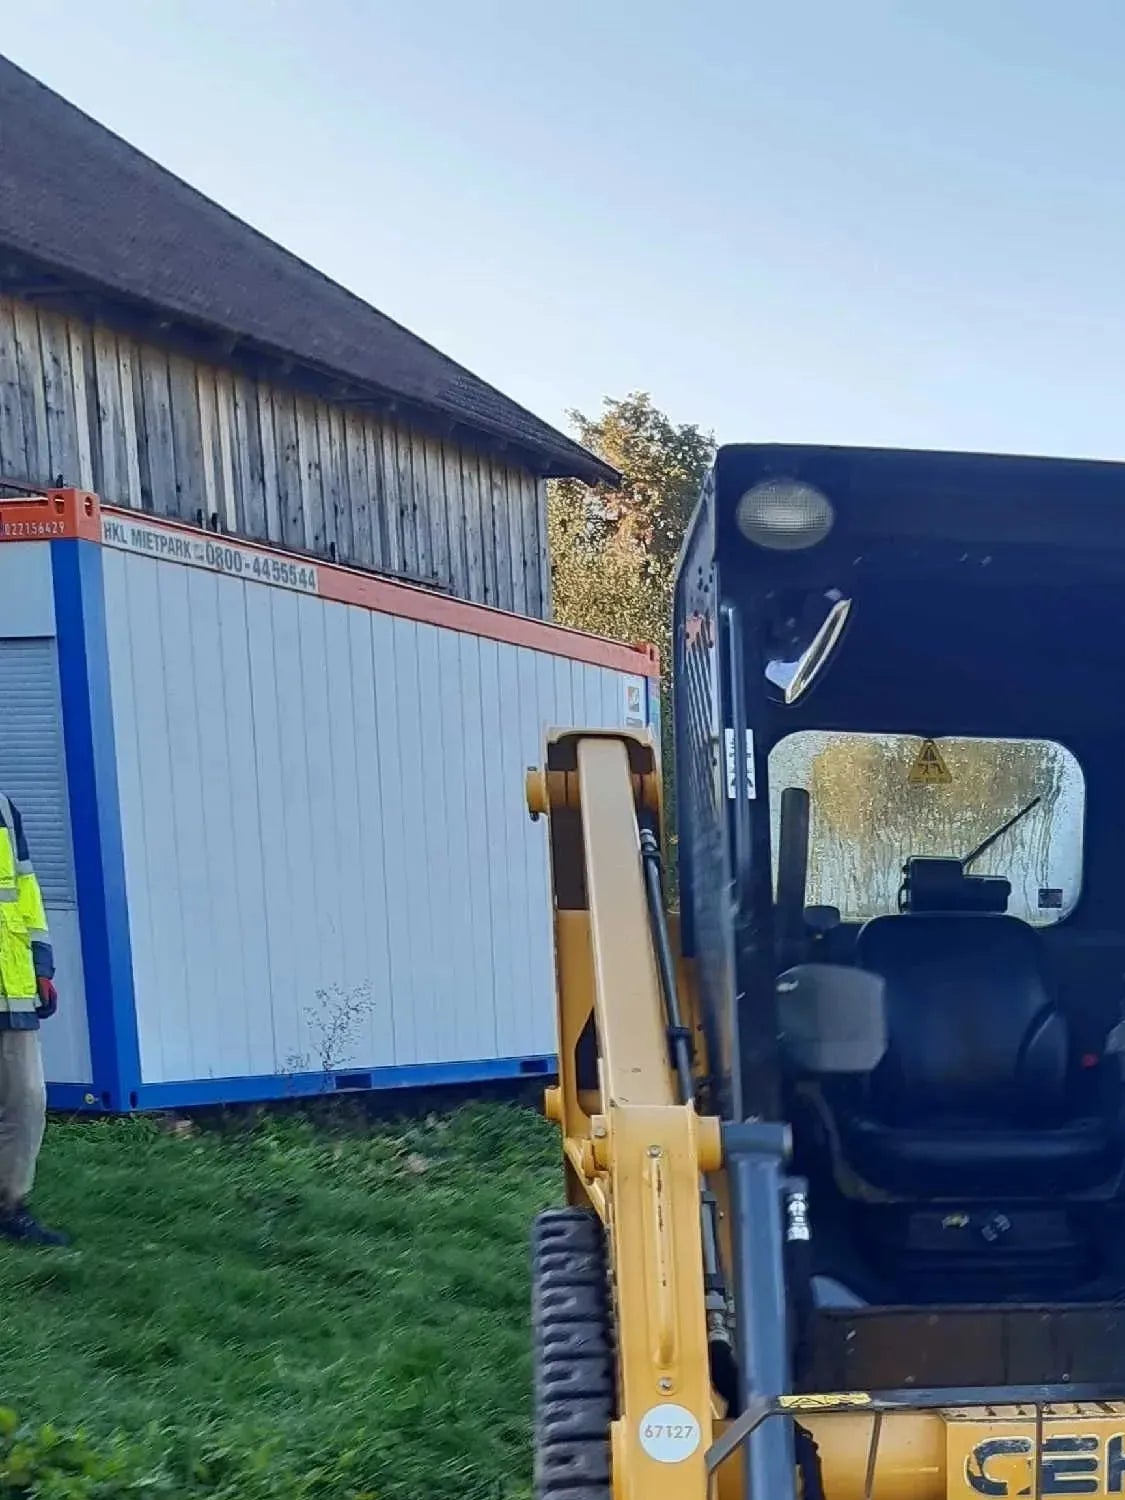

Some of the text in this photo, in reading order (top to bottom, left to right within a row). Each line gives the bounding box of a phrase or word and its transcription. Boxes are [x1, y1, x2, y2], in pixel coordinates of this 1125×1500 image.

[104, 521, 128, 544] HKL
[131, 528, 192, 560] MIETPARK
[644, 1424, 694, 1439] 67127
